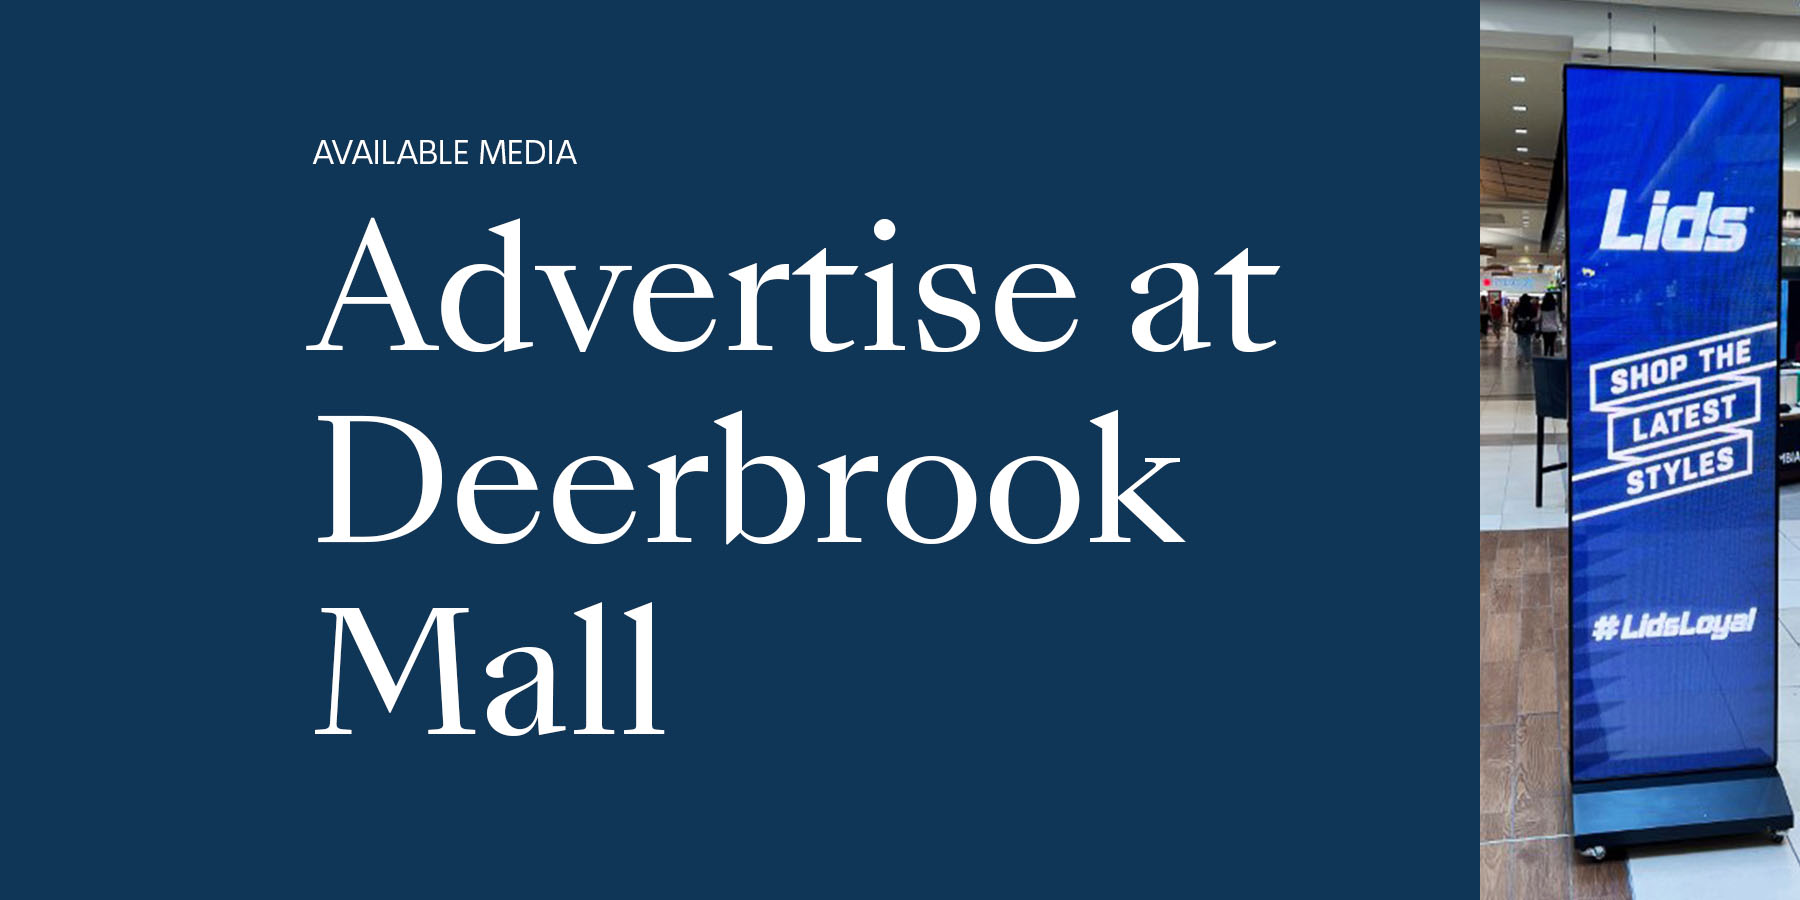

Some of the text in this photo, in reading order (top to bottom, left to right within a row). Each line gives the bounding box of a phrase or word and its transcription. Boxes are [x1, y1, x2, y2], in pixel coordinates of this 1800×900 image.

[1599, 188, 1748, 252] Lids
[1610, 338, 1751, 394] SHOP THE
[1633, 394, 1736, 442] LATEST
[1626, 446, 1734, 494] STYLES
[1592, 607, 1757, 642] #LidsLoyal
